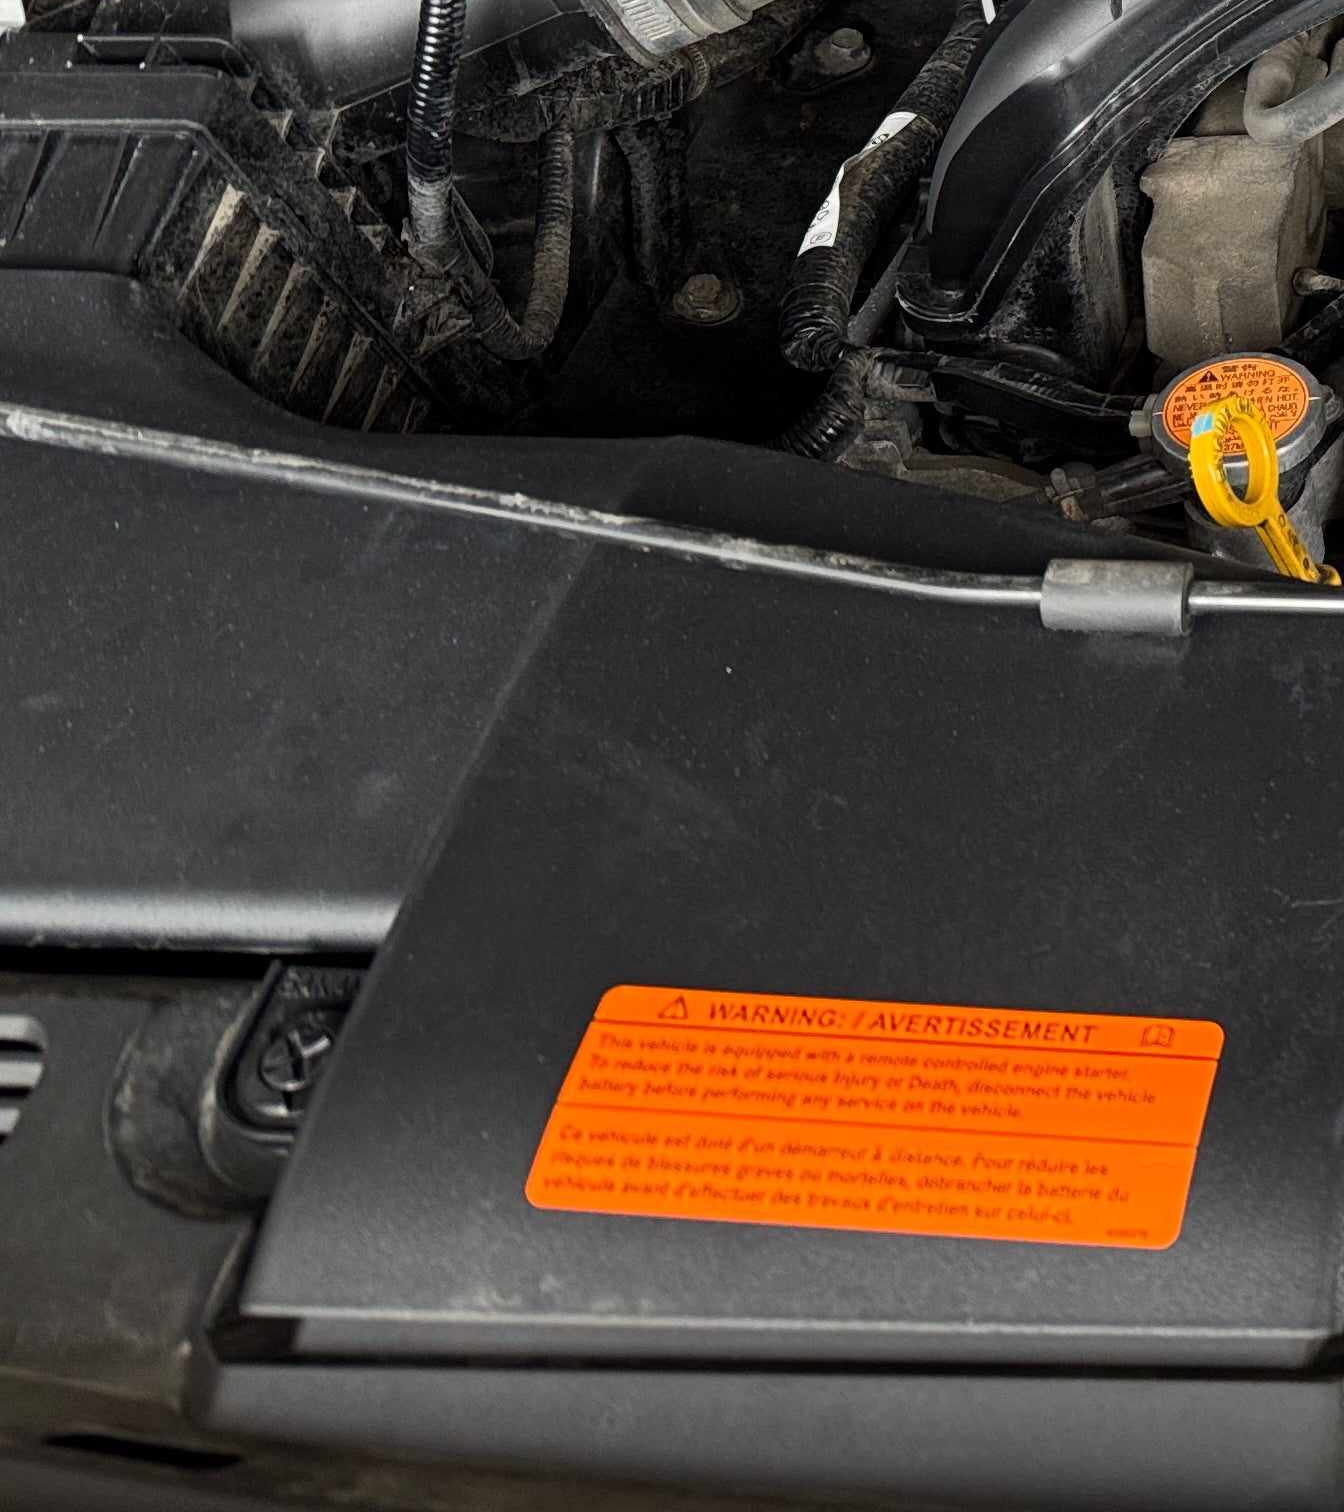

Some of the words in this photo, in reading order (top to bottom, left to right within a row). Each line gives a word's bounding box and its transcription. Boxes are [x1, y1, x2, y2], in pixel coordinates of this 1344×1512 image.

[1220, 369, 1276, 382] WARNING
[704, 1002, 848, 1028] WARNING:
[866, 1012, 1099, 1044] AVERTISSEMENT
